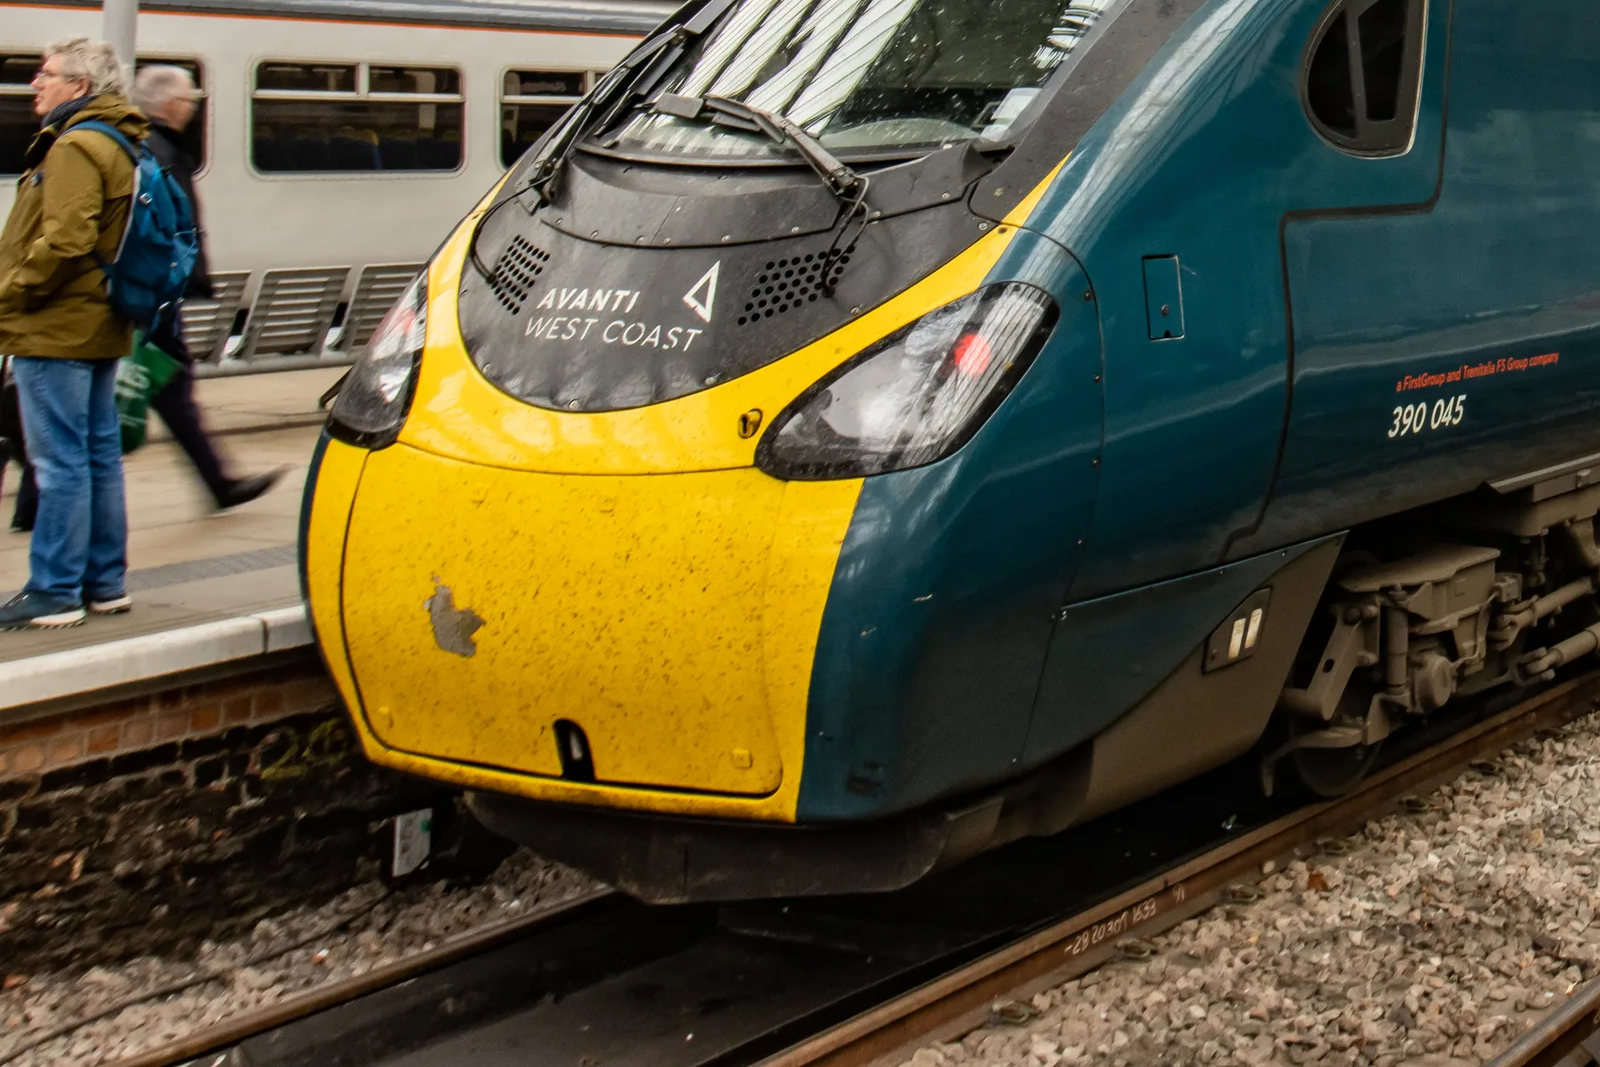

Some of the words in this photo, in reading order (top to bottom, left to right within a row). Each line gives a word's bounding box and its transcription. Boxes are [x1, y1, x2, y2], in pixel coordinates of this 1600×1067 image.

[536, 288, 641, 314] AVANTI
[525, 316, 599, 341] WEST
[602, 320, 703, 352] COAST
[1396, 381, 1402, 392] a
[1403, 372, 1446, 391] FirstGroup
[1447, 366, 1462, 382] and
[1463, 361, 1495, 379] Trenitalia
[1496, 358, 1506, 372] FS
[1507, 357, 1528, 371] Group
[1529, 352, 1560, 367] company
[1387, 401, 1427, 438] 390
[1430, 394, 1467, 430] 045
